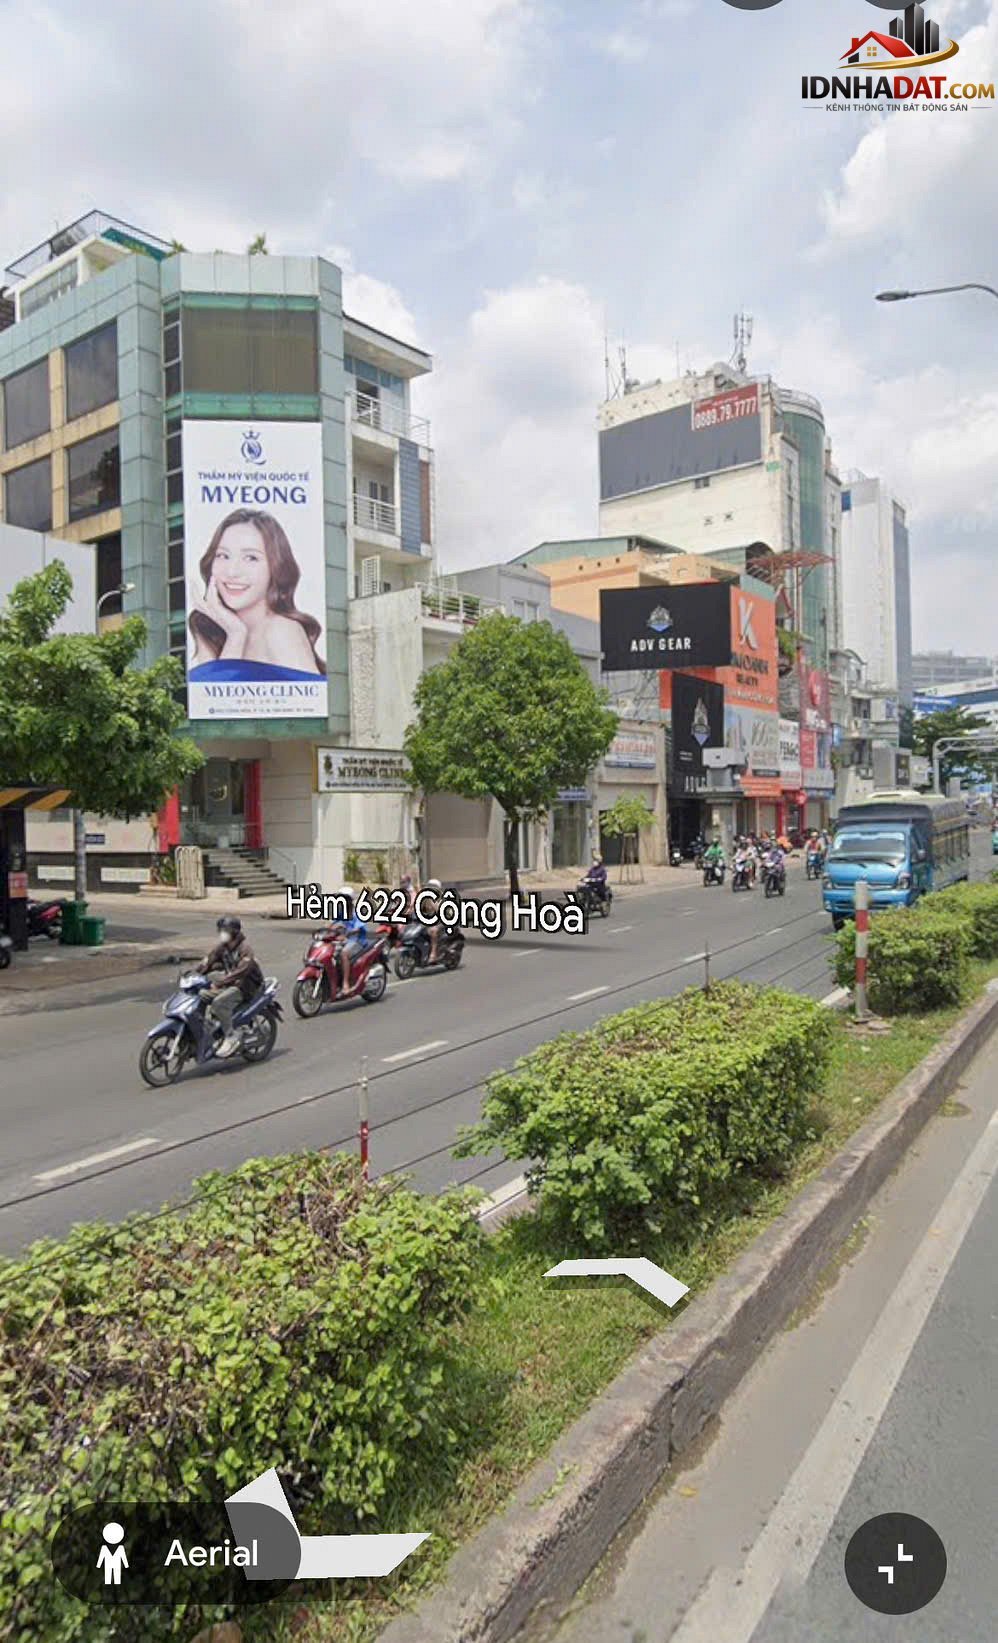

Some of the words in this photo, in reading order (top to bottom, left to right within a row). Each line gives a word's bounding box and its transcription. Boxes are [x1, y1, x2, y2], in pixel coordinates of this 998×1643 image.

[201, 485, 307, 504] MYEONG
[658, 637, 691, 651] GEAR
[204, 685, 267, 698] MYEONG
[270, 684, 319, 697] CLINIC
